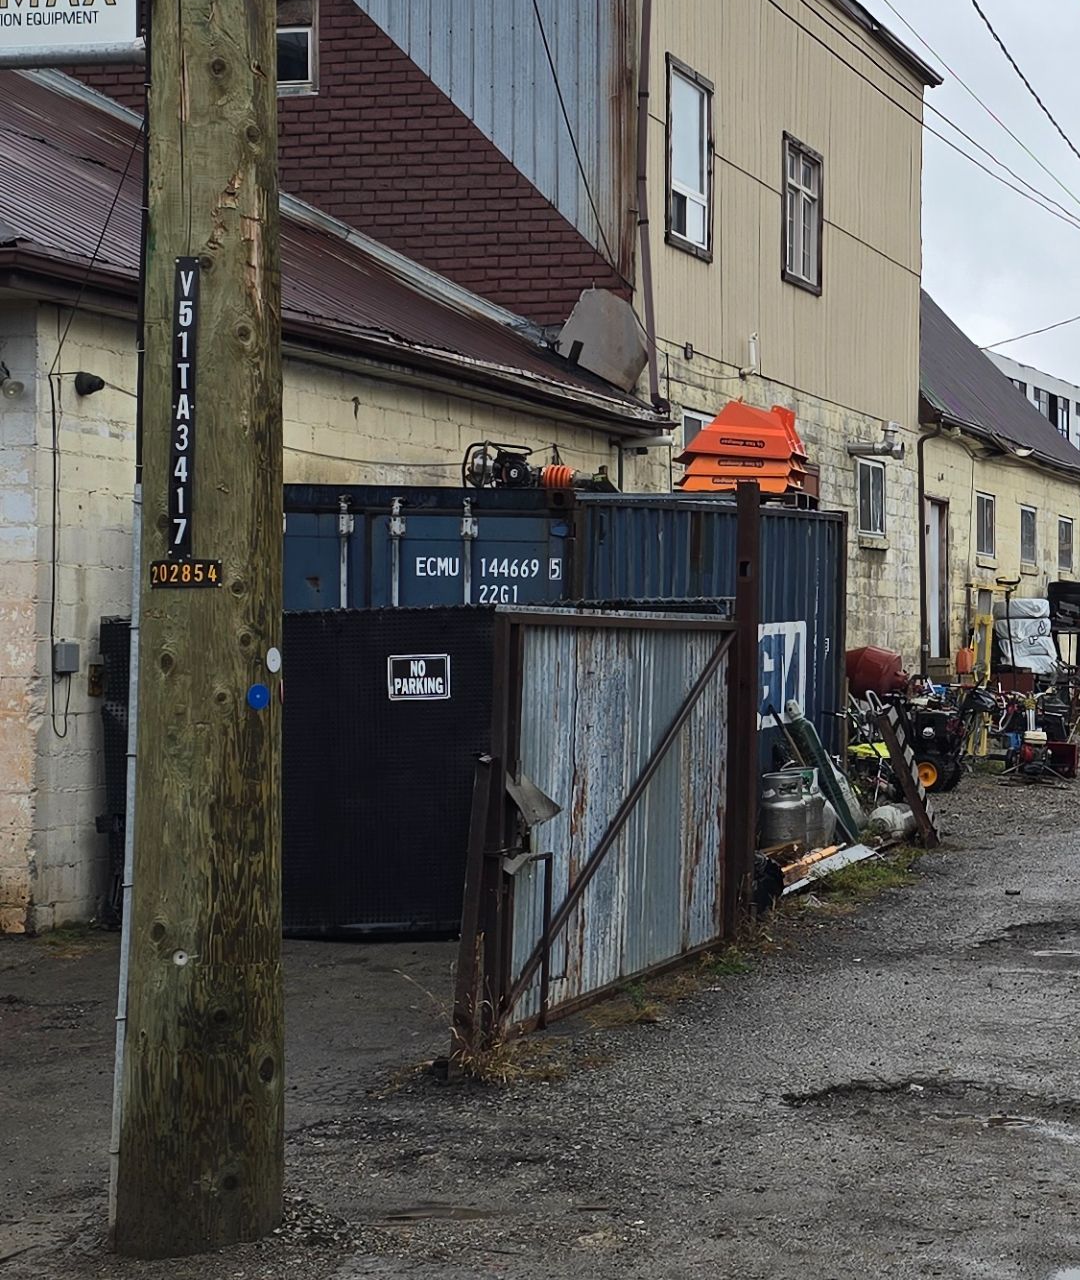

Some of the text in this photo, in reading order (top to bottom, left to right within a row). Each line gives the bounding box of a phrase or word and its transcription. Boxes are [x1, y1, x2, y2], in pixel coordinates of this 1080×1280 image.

[27, 11, 99, 25] EQUIPMENT
[173, 270, 194, 545] V51TA3417
[152, 564, 217, 583] 202854
[416, 557, 560, 578] ECMU 144669 5
[479, 585, 518, 603] 22G1
[410, 660, 426, 677] NO
[394, 677, 444, 694] PARKING
